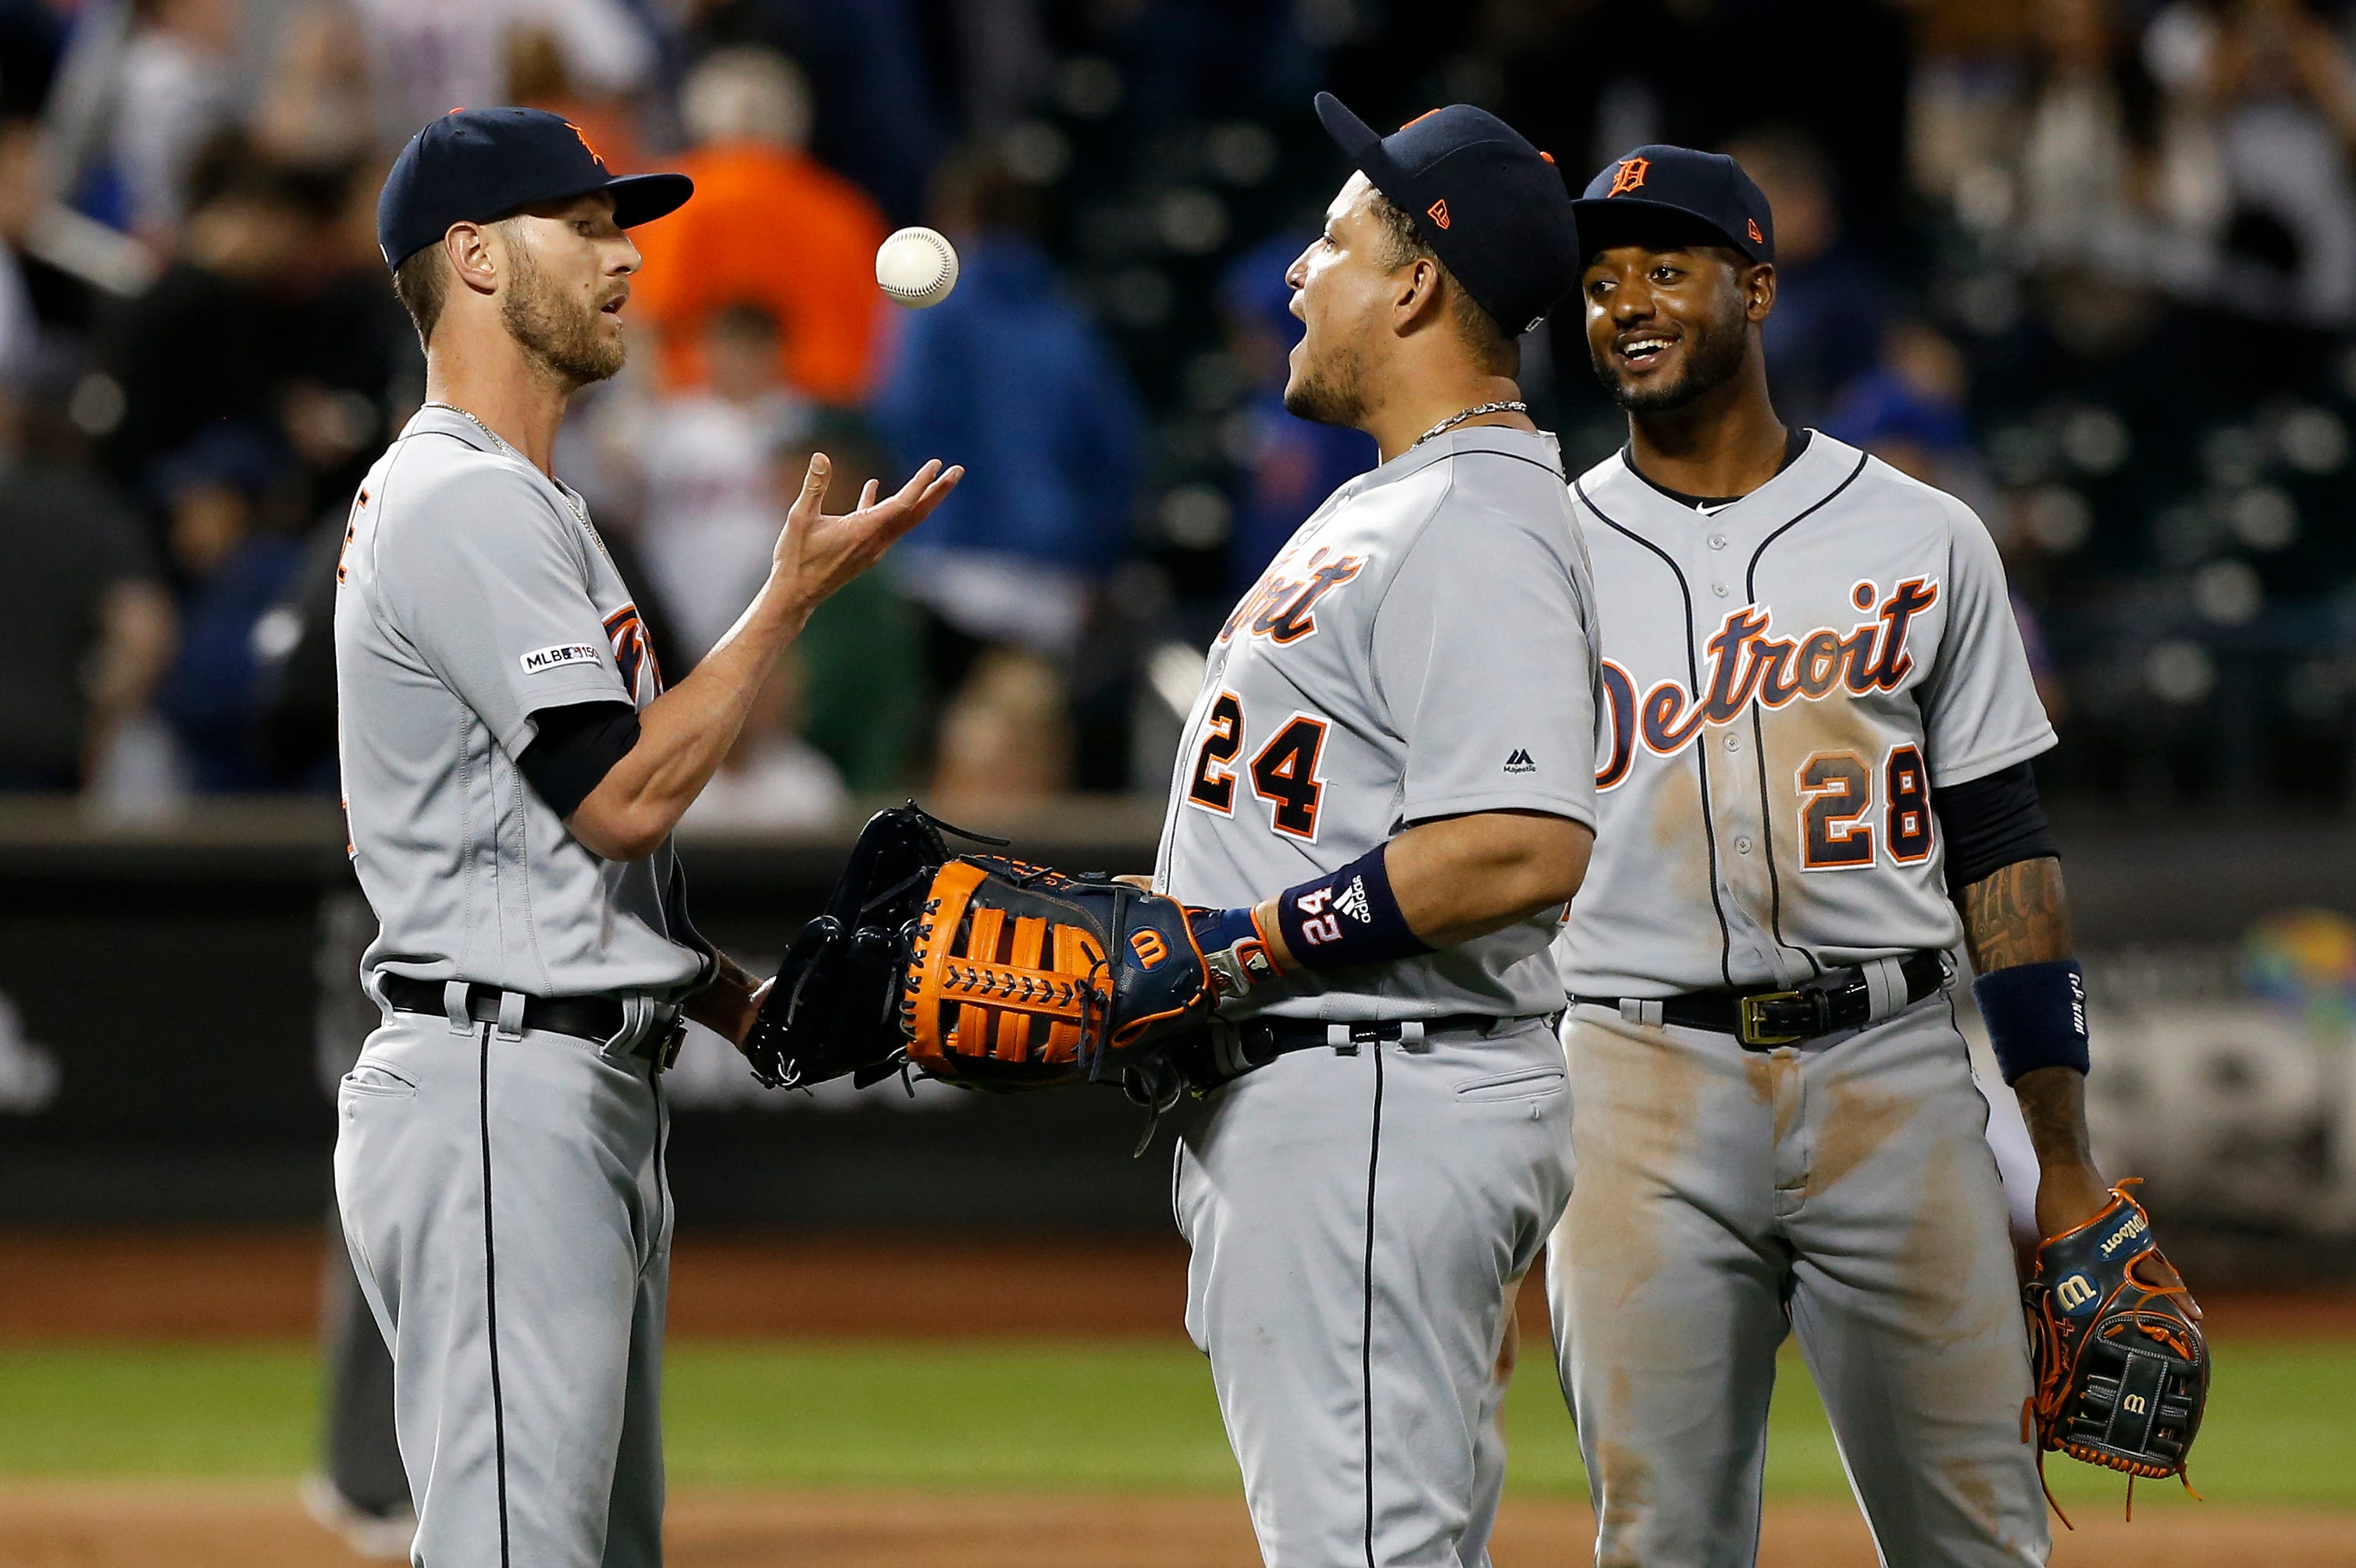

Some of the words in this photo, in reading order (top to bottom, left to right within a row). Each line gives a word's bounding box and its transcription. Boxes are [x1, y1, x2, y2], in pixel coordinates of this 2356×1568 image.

[526, 650, 562, 669] MLB
[1186, 685, 1334, 845] 24
[1503, 765, 1536, 774] Majestic
[1795, 741, 1936, 873] 28
[1297, 886, 1343, 946] 24
[1352, 875, 1371, 924] adidas
[2100, 1213, 2147, 1254] Wilson
